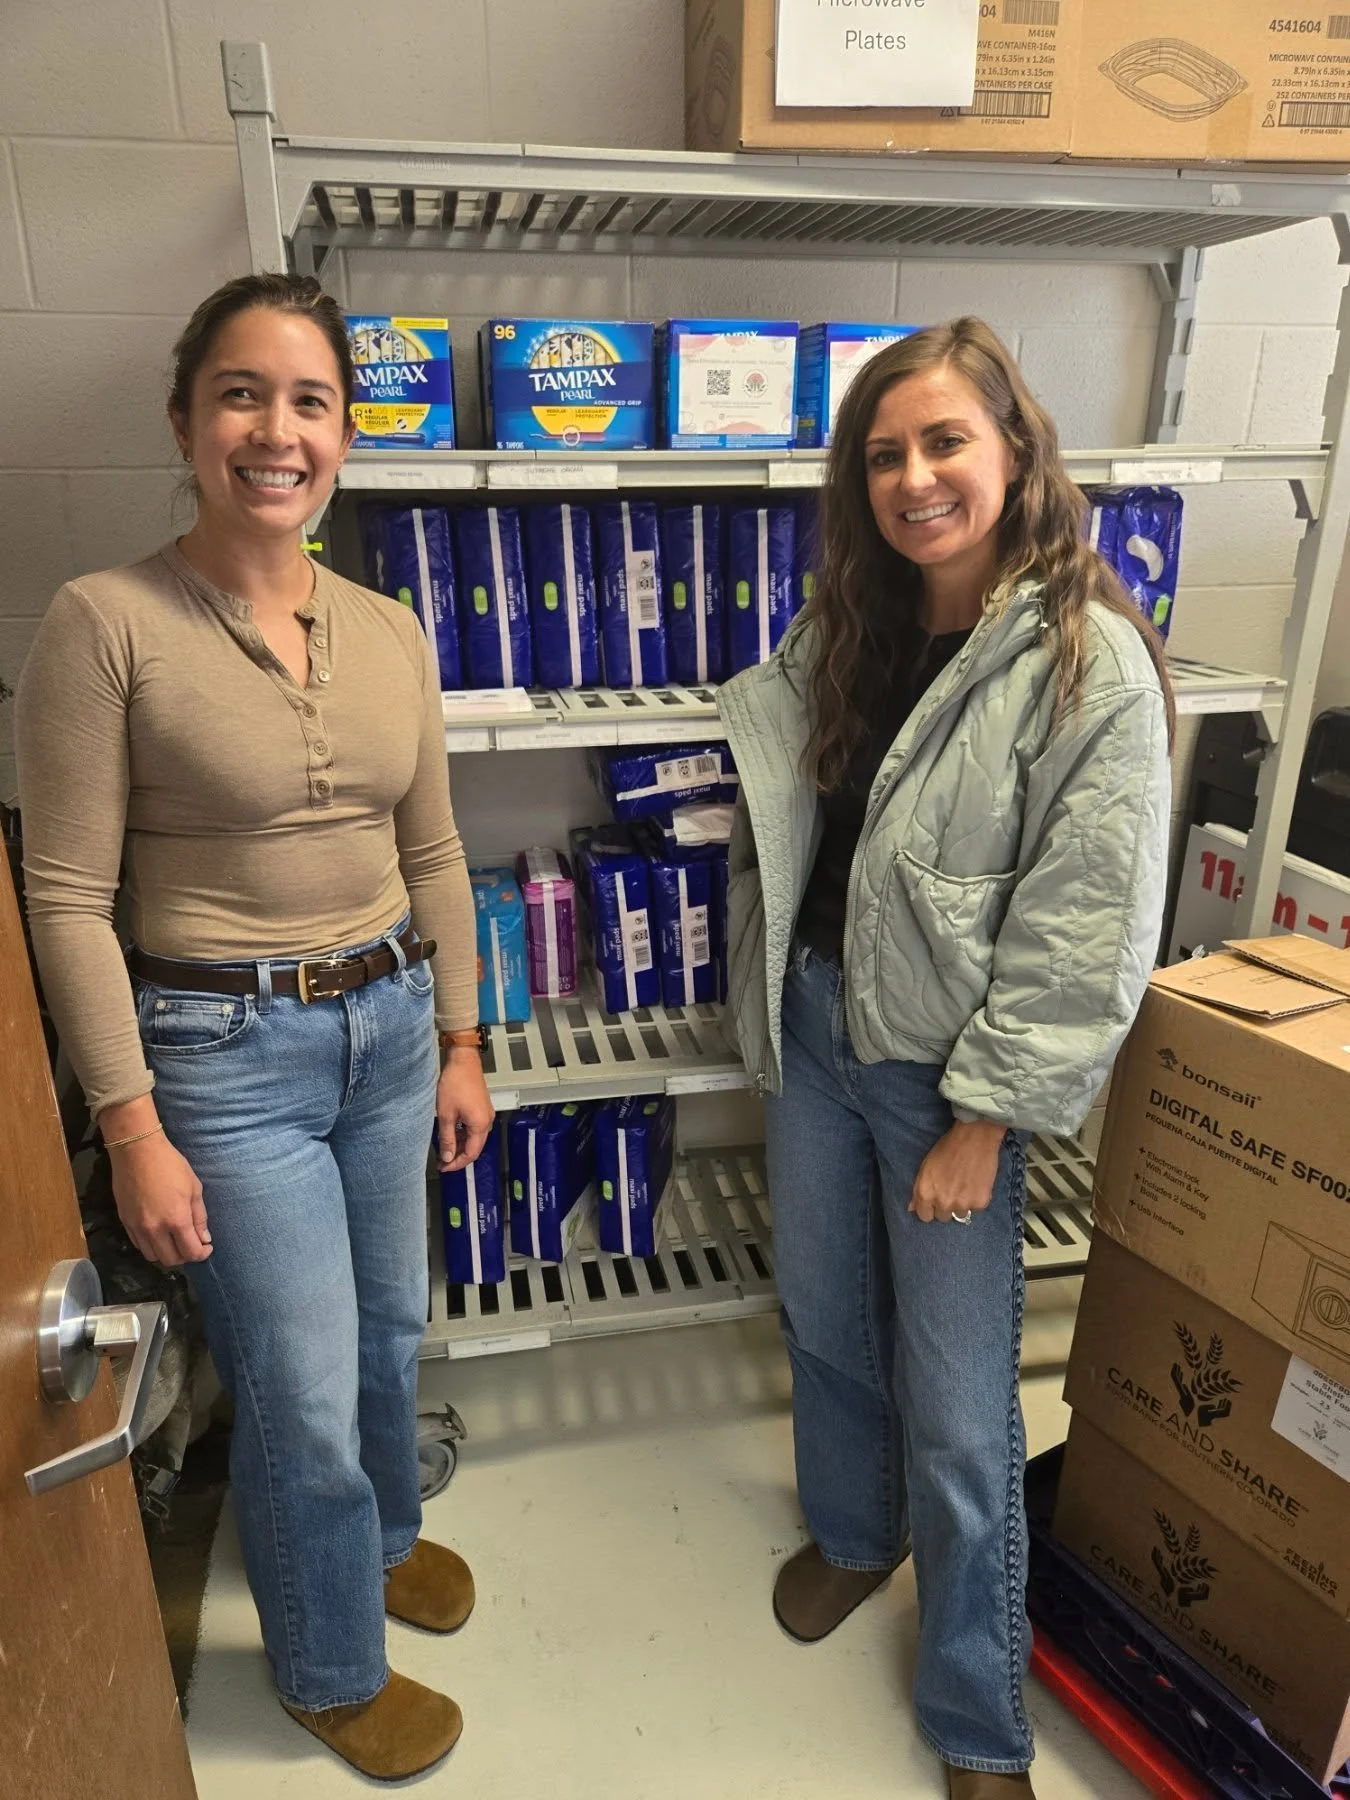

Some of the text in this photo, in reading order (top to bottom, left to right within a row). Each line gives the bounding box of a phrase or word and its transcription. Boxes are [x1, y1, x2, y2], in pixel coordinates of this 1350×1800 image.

[980, 5, 997, 19] 04
[1269, 19, 1322, 33] 4541604
[845, 30, 906, 50] Plates
[977, 41, 992, 49] AVE
[1269, 54, 1315, 62] MICROWAVE
[975, 80, 1053, 90] ONTAINERS PER CASE
[1276, 91, 1290, 99] 252
[1290, 92, 1336, 100] CONTAINERS
[494, 325, 516, 340] 96
[353, 364, 429, 387] AMPAX
[528, 368, 617, 392] TAMPAX
[355, 408, 363, 420] R
[616, 569, 627, 612] maxi pads
[769, 572, 778, 615] maxi pads
[433, 603, 444, 624] pads
[507, 602, 518, 621] pads
[577, 594, 587, 617] pads
[706, 594, 715, 615] pads
[1182, 1065, 1258, 1109] bonsaii
[1150, 1088, 1224, 1140] DIGITAL
[1229, 1129, 1287, 1170] SAFE
[1184, 1131, 1207, 1149] CAJA
[1208, 1144, 1242, 1168] FUERTE
[1242, 1160, 1279, 1186] DIGITAL
[1142, 1177, 1172, 1199] Includes
[1163, 1171, 1185, 1188] Alarm
[629, 1194, 637, 1209] pads
[479, 1220, 488, 1235] pads
[1107, 1367, 1301, 1518] CARE AND SHARE
[1236, 1480, 1296, 1528] COLORADO
[1283, 1554, 1336, 1599] AMERICA
[1286, 1547, 1338, 1590] FEEDING
[1090, 1544, 1278, 1697] CARE AND SHARE
